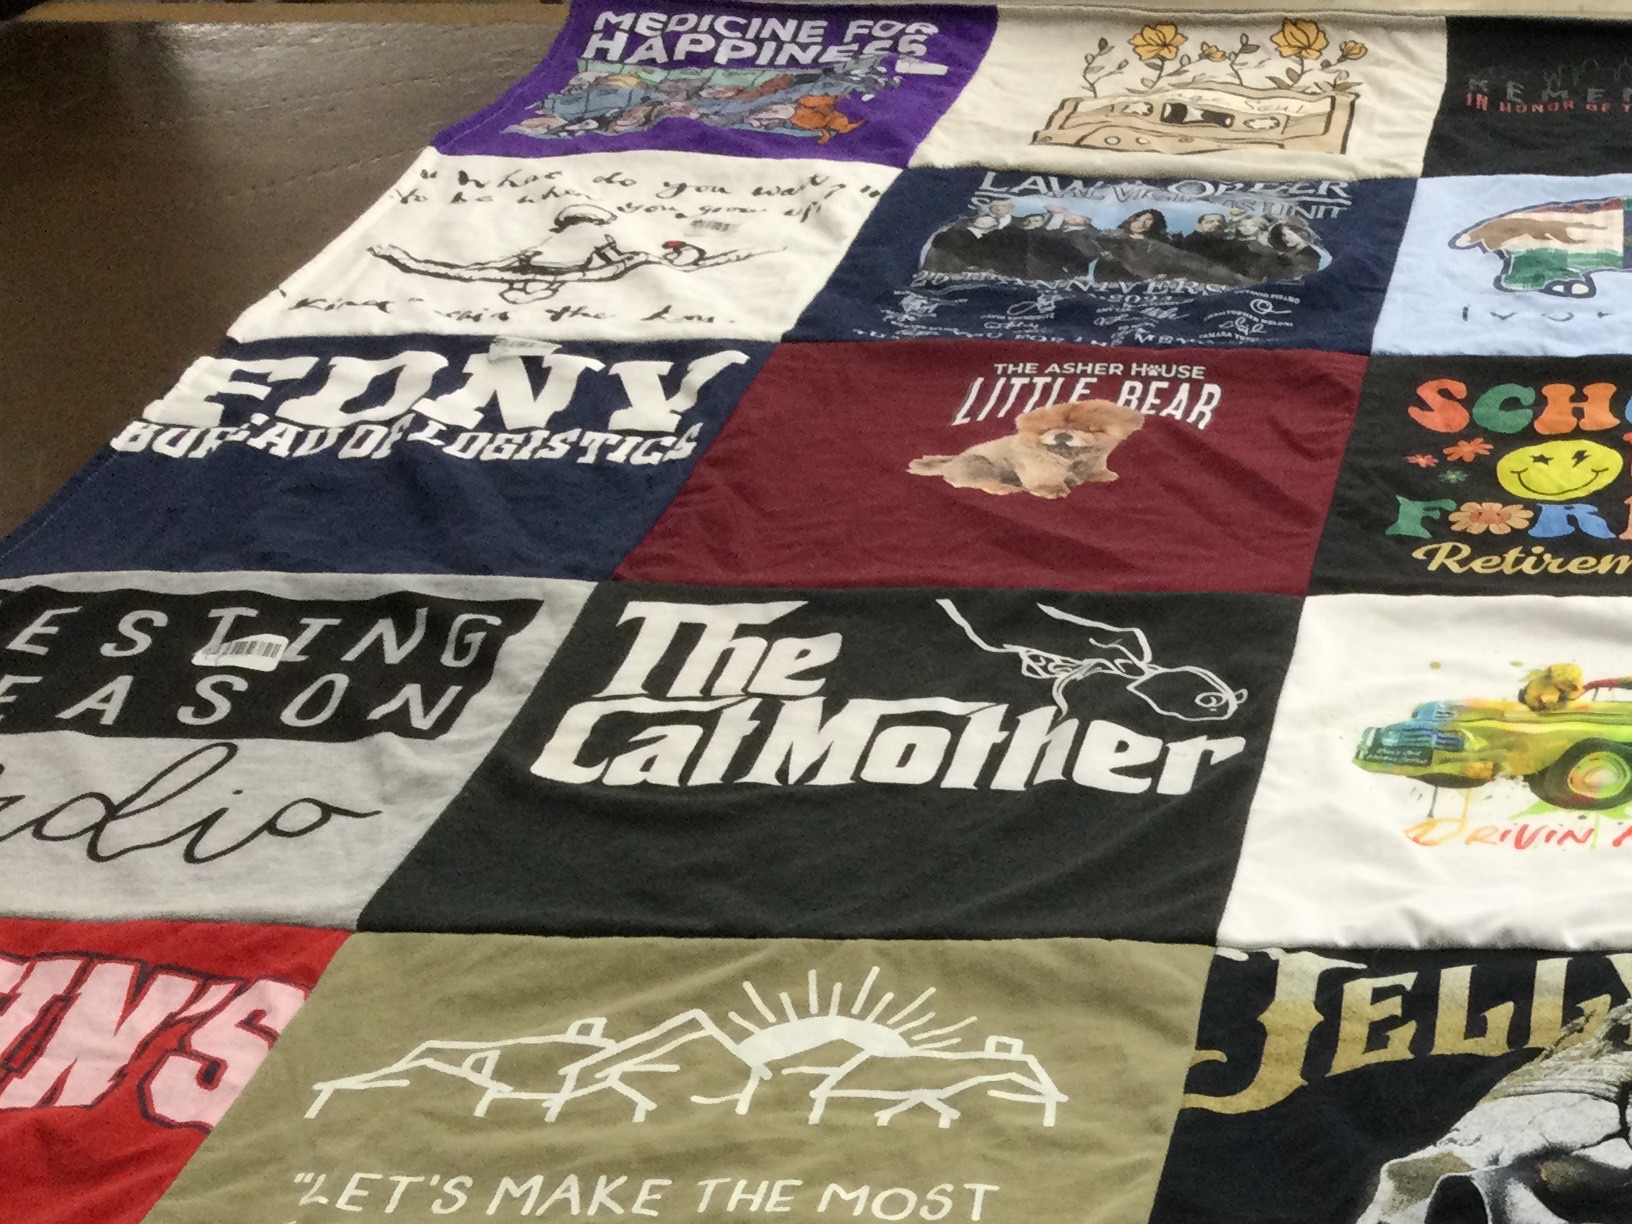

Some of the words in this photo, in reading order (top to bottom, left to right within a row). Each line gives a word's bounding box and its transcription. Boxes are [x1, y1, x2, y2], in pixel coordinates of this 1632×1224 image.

[582, 30, 928, 67] HAPPINESS
[592, 11, 829, 43] MEDICINE
[843, 20, 939, 43] FOR
[143, 349, 751, 433] FDNY
[993, 362, 1038, 375] THE
[1043, 362, 1124, 377] ASHER
[950, 376, 1099, 427] LITTLE
[1116, 381, 1222, 430] BEAR
[408, 420, 703, 466] LOGISTICS
[593, 600, 844, 699] The
[486, 1174, 663, 1218] MAKE
[673, 1179, 800, 1216] THE
[816, 1181, 1001, 1224] MOST
